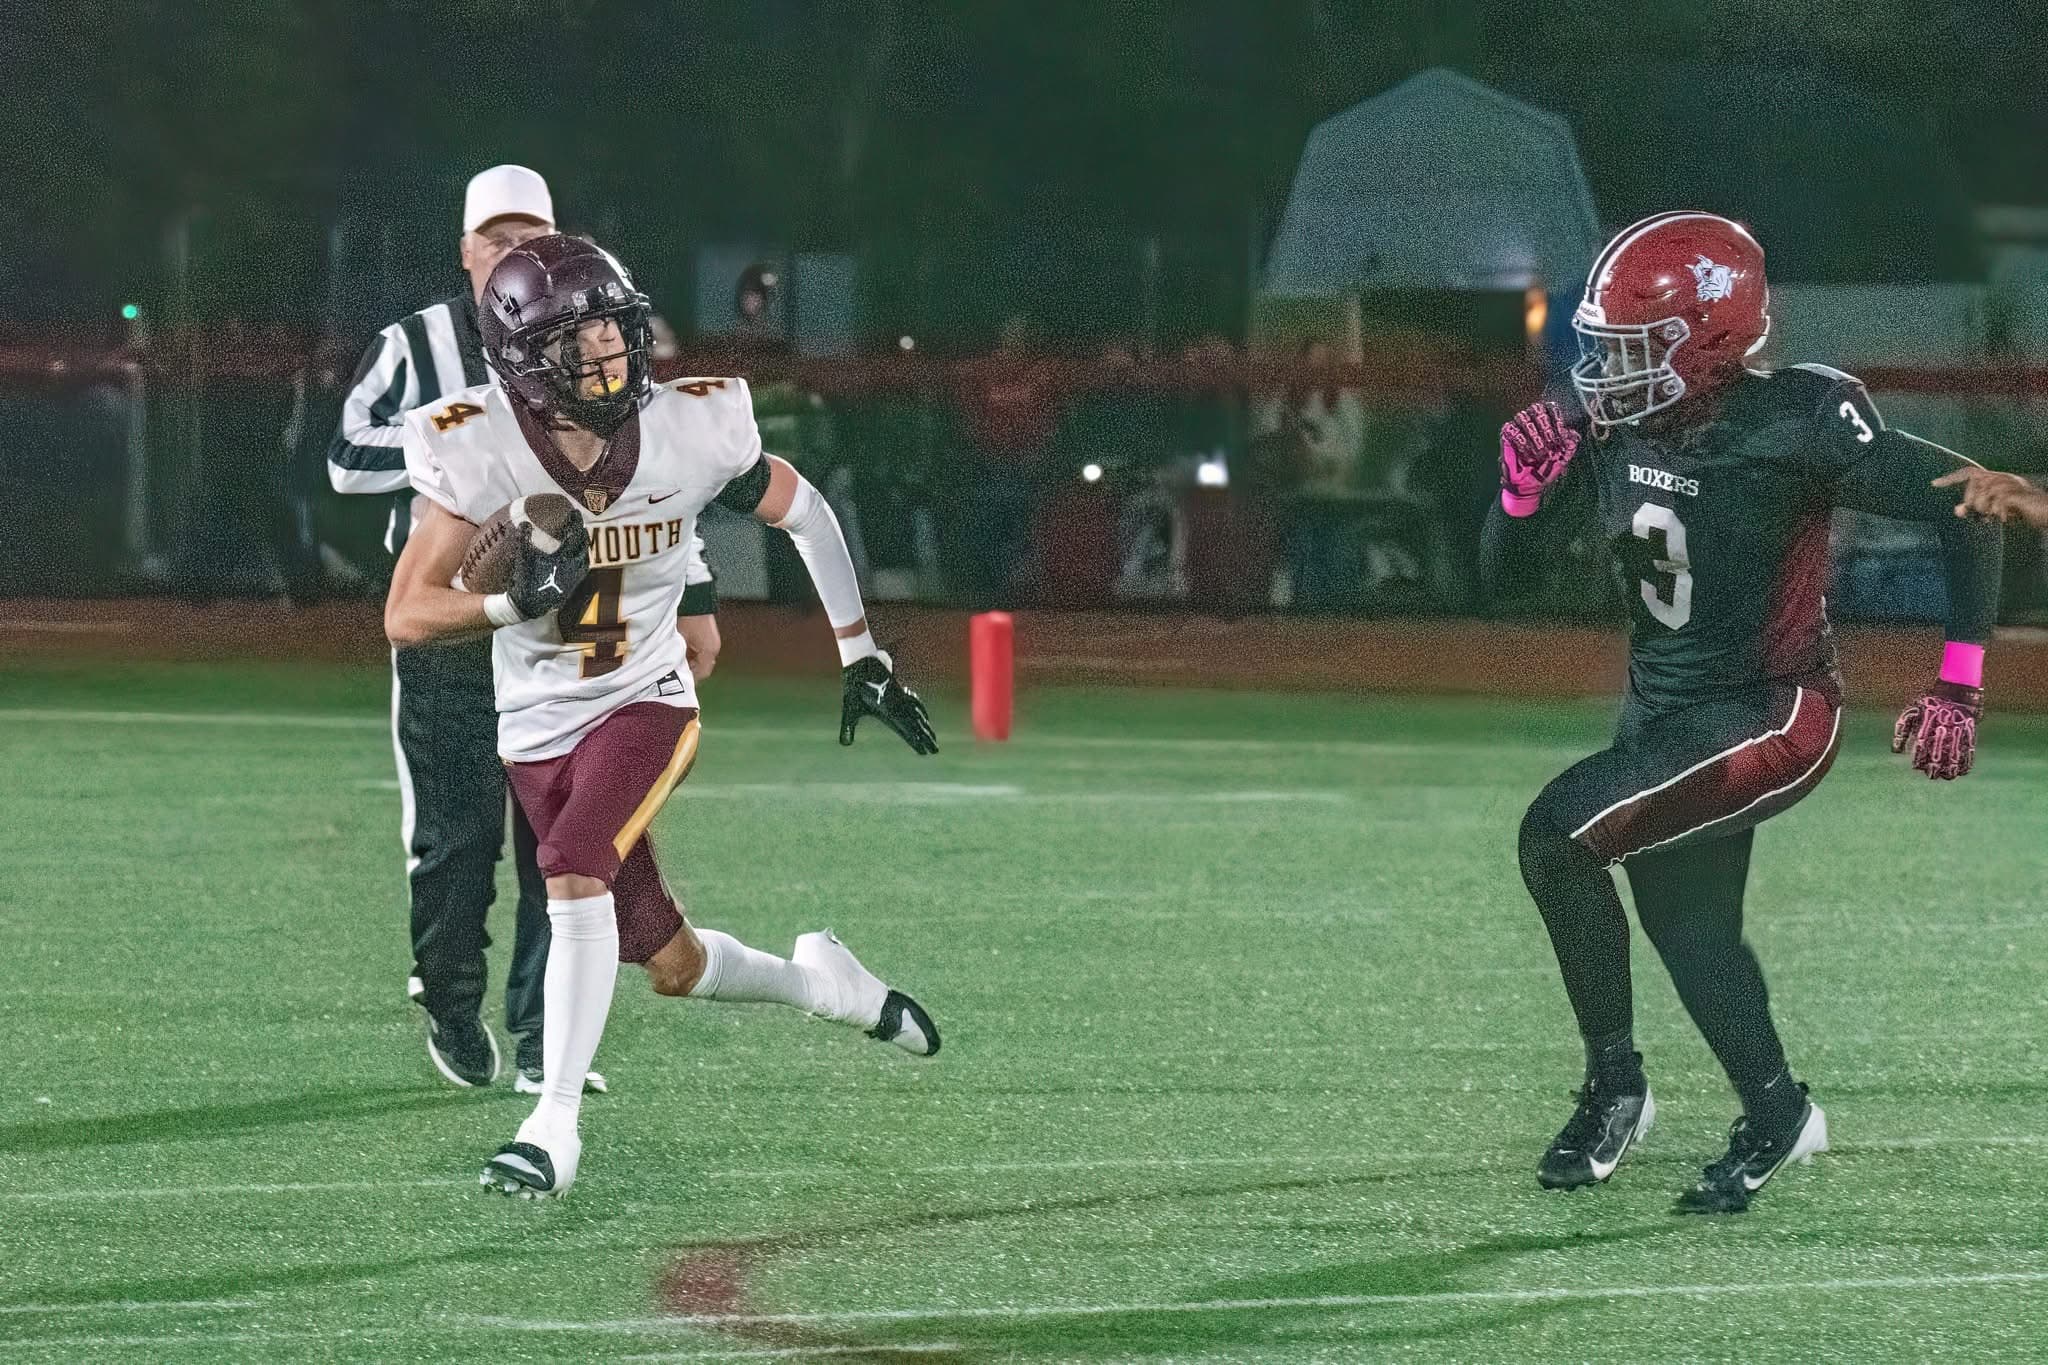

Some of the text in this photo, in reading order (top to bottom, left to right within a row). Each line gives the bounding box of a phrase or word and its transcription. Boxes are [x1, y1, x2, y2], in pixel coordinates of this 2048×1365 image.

[674, 380, 726, 399] 4
[431, 402, 485, 432] 4
[1839, 401, 1874, 443] 3
[1628, 464, 1699, 496] BOXERS
[1632, 502, 1693, 630] 3
[558, 567, 630, 680] 4
